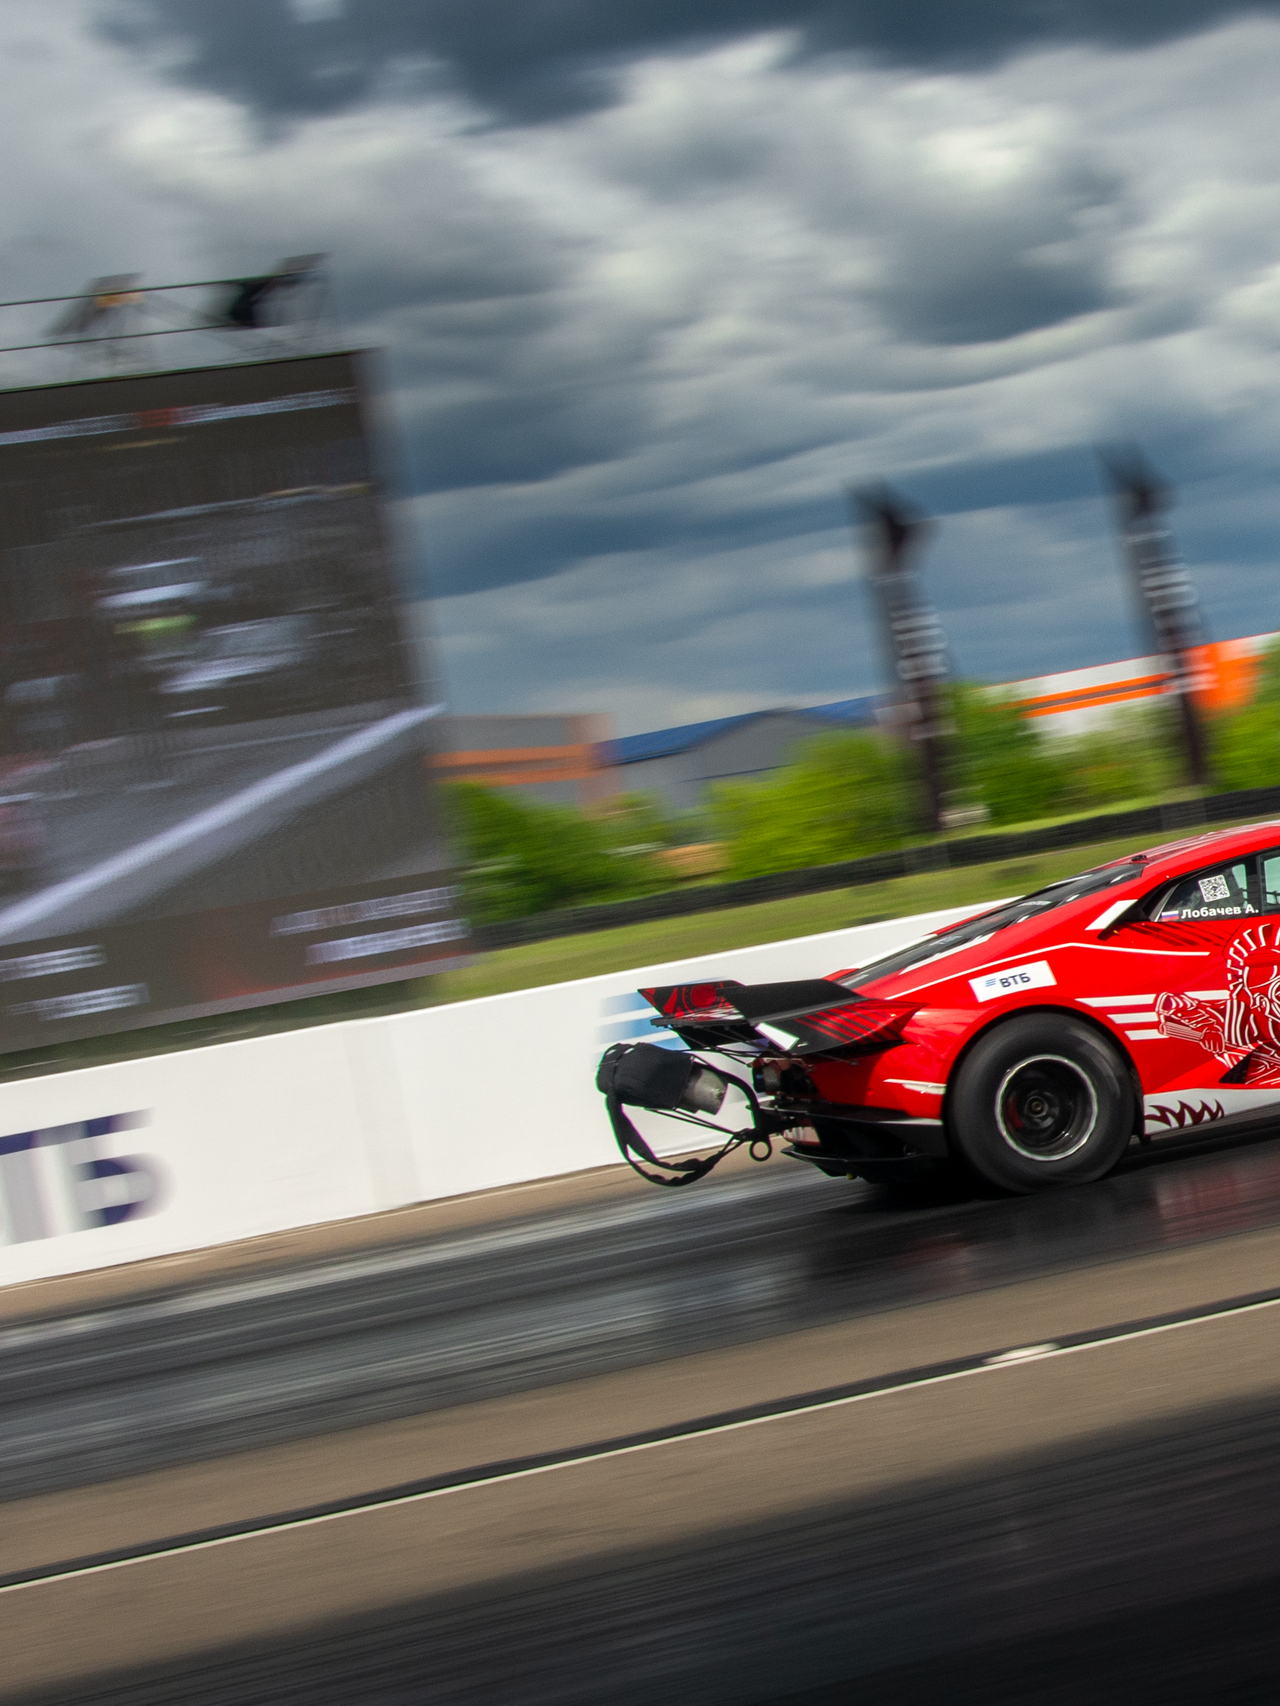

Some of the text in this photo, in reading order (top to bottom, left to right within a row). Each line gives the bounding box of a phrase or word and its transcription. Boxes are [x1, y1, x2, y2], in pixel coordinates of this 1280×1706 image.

[1181, 904, 1259, 920] Лобачев А.
[999, 972, 1031, 989] ВТБ
